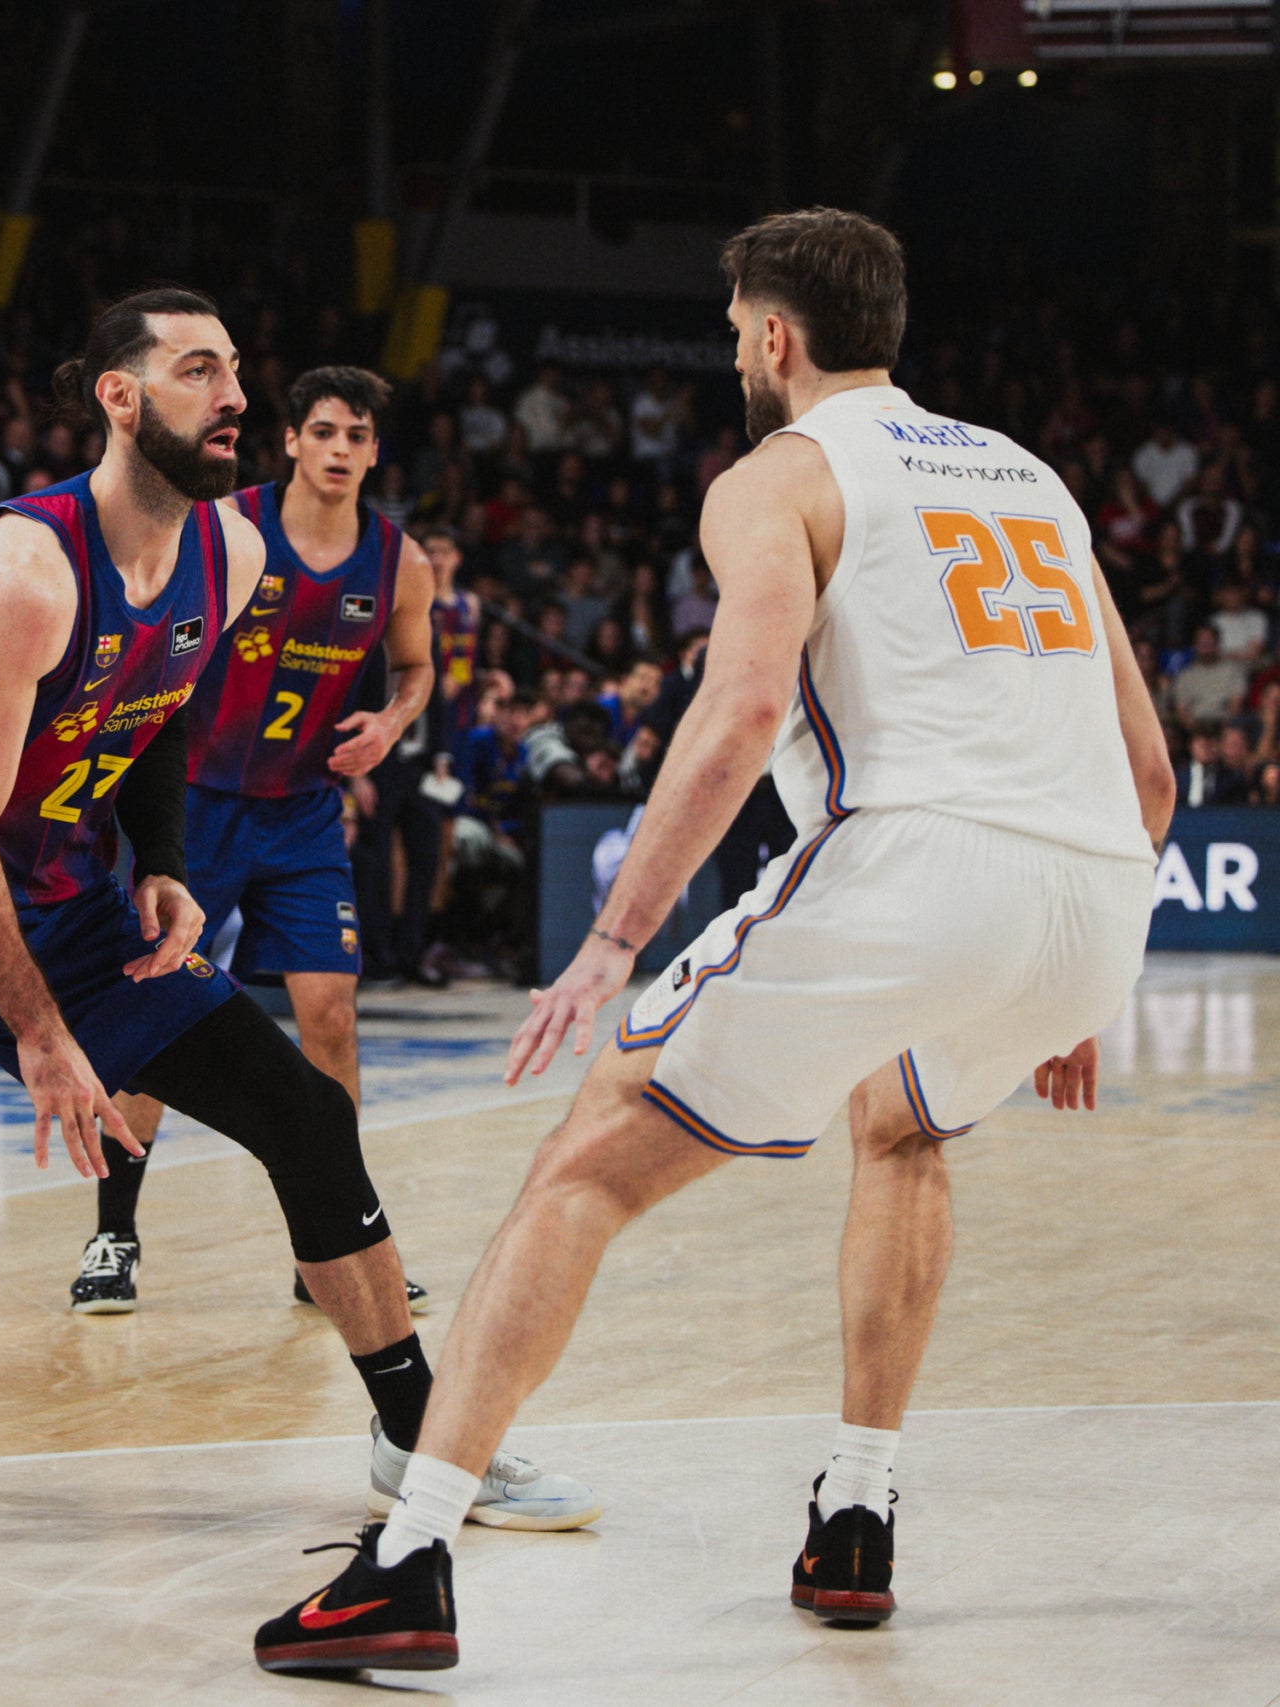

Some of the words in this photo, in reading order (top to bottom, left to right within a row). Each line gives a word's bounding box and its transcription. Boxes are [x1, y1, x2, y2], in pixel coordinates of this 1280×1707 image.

[914, 506, 1098, 658] 25
[263, 691, 304, 740] 2
[39, 753, 134, 824] 27
